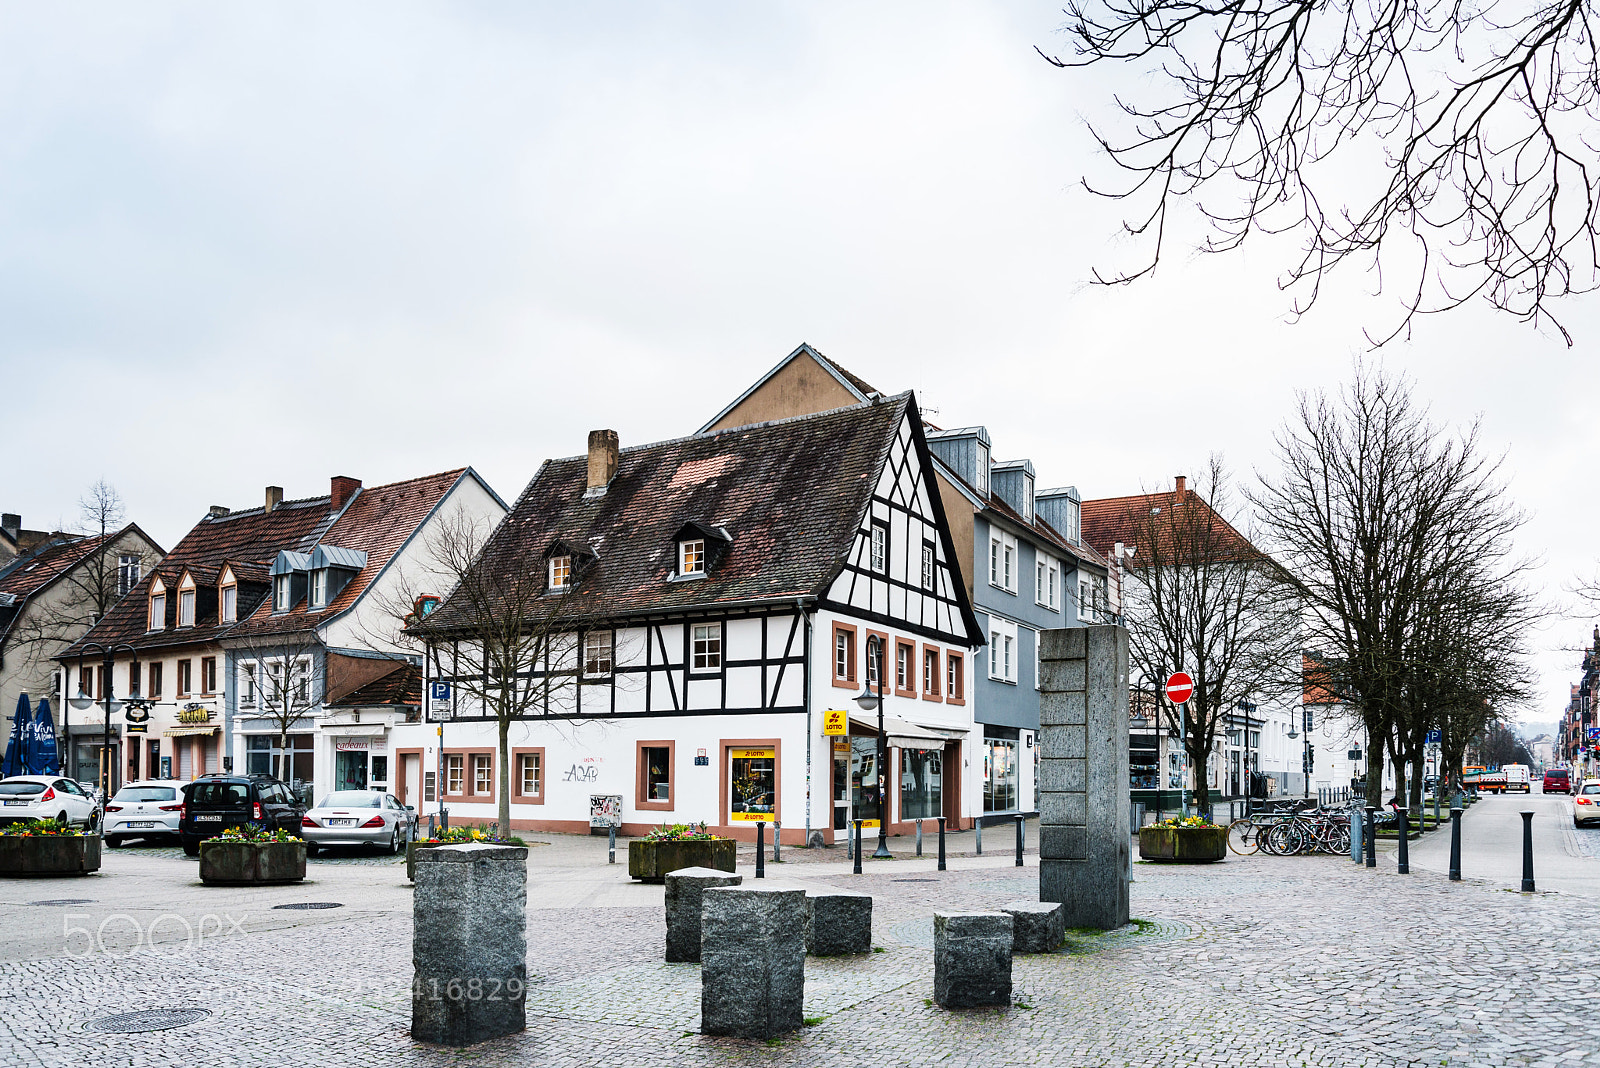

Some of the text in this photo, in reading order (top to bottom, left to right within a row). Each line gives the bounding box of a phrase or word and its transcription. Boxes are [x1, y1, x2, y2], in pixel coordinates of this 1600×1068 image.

[436, 684, 446, 697] P
[1432, 732, 1439, 740] P
[336, 737, 369, 751] cadeaux
